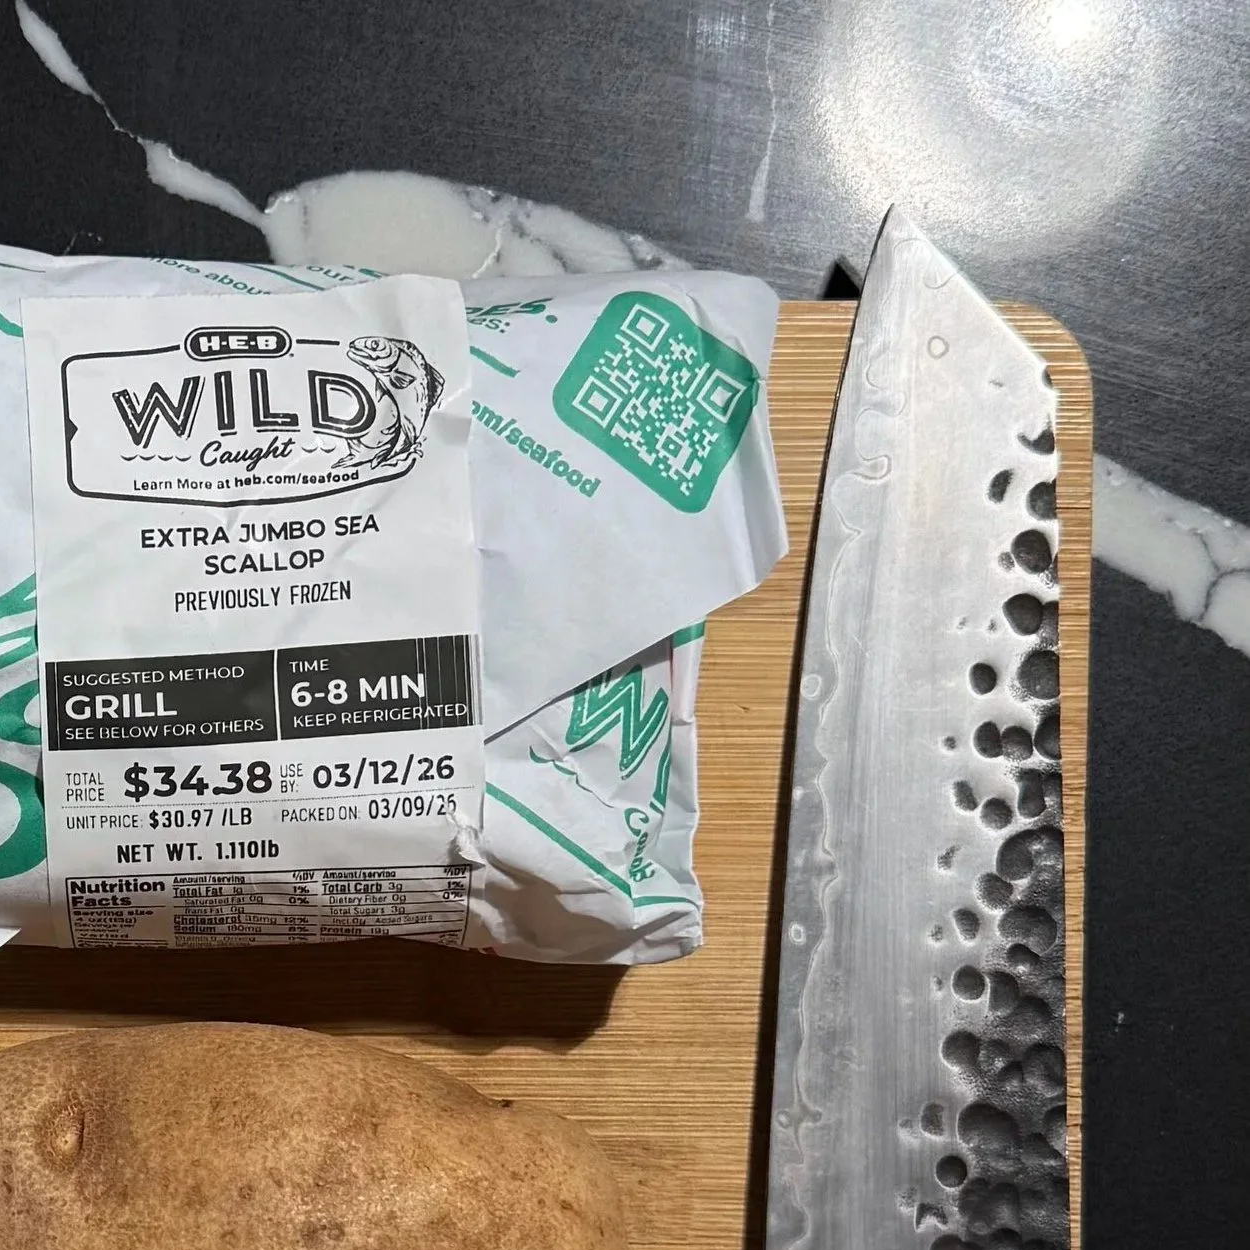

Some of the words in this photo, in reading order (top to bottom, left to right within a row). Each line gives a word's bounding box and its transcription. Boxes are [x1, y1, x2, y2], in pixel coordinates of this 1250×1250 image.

[198, 334, 280, 350] H-E-B
[112, 368, 378, 448] WILD
[200, 436, 296, 472] Caught
[132, 479, 172, 491] Learn
[176, 478, 212, 490] More
[216, 478, 231, 490] at
[234, 470, 360, 488] heb.com/seafood
[140, 526, 230, 549] EXTRA
[238, 518, 326, 546] JUMBO
[334, 514, 380, 537] SEA
[204, 548, 326, 576] SCALLOP
[174, 587, 280, 613] PREVIOUSLY
[290, 580, 351, 605] FROZEN
[289, 658, 330, 673] TIME
[62, 670, 165, 687] SUGGESTED
[168, 665, 245, 681] METHOD
[290, 679, 348, 708] 6-8
[358, 672, 426, 702] MIN
[64, 692, 178, 720] GRILL
[293, 713, 338, 728] KEEP
[341, 702, 468, 726] REFRIGERATED
[64, 726, 96, 741] SEE
[98, 724, 159, 740] BELOW
[163, 722, 196, 738] FOR
[199, 719, 264, 736] OTHERS
[66, 772, 104, 786] TOTAL
[124, 760, 272, 802] $34.38
[280, 764, 304, 779] USE
[312, 754, 456, 790] 03/12/26
[66, 788, 105, 802] PRICE
[280, 779, 300, 794] BY:
[66, 815, 97, 830] UNIT
[99, 814, 144, 830] PRICE:
[148, 808, 214, 830] $30.97
[220, 808, 252, 827] /LB
[280, 806, 338, 824] PACKED
[339, 806, 360, 822] ON:
[117, 844, 154, 864] NET
[166, 842, 203, 862] WT.
[216, 839, 279, 860] 1.110lb
[173, 874, 246, 884] Amount/serving
[322, 870, 396, 881] Amount/serving
[70, 878, 166, 894] Nutrition
[172, 886, 202, 897] Total
[205, 886, 224, 896] Fat
[322, 882, 350, 894] Total
[354, 882, 382, 892] Carb
[71, 894, 132, 907] Facts
[328, 895, 362, 905] Dietary
[329, 906, 351, 915] Total
